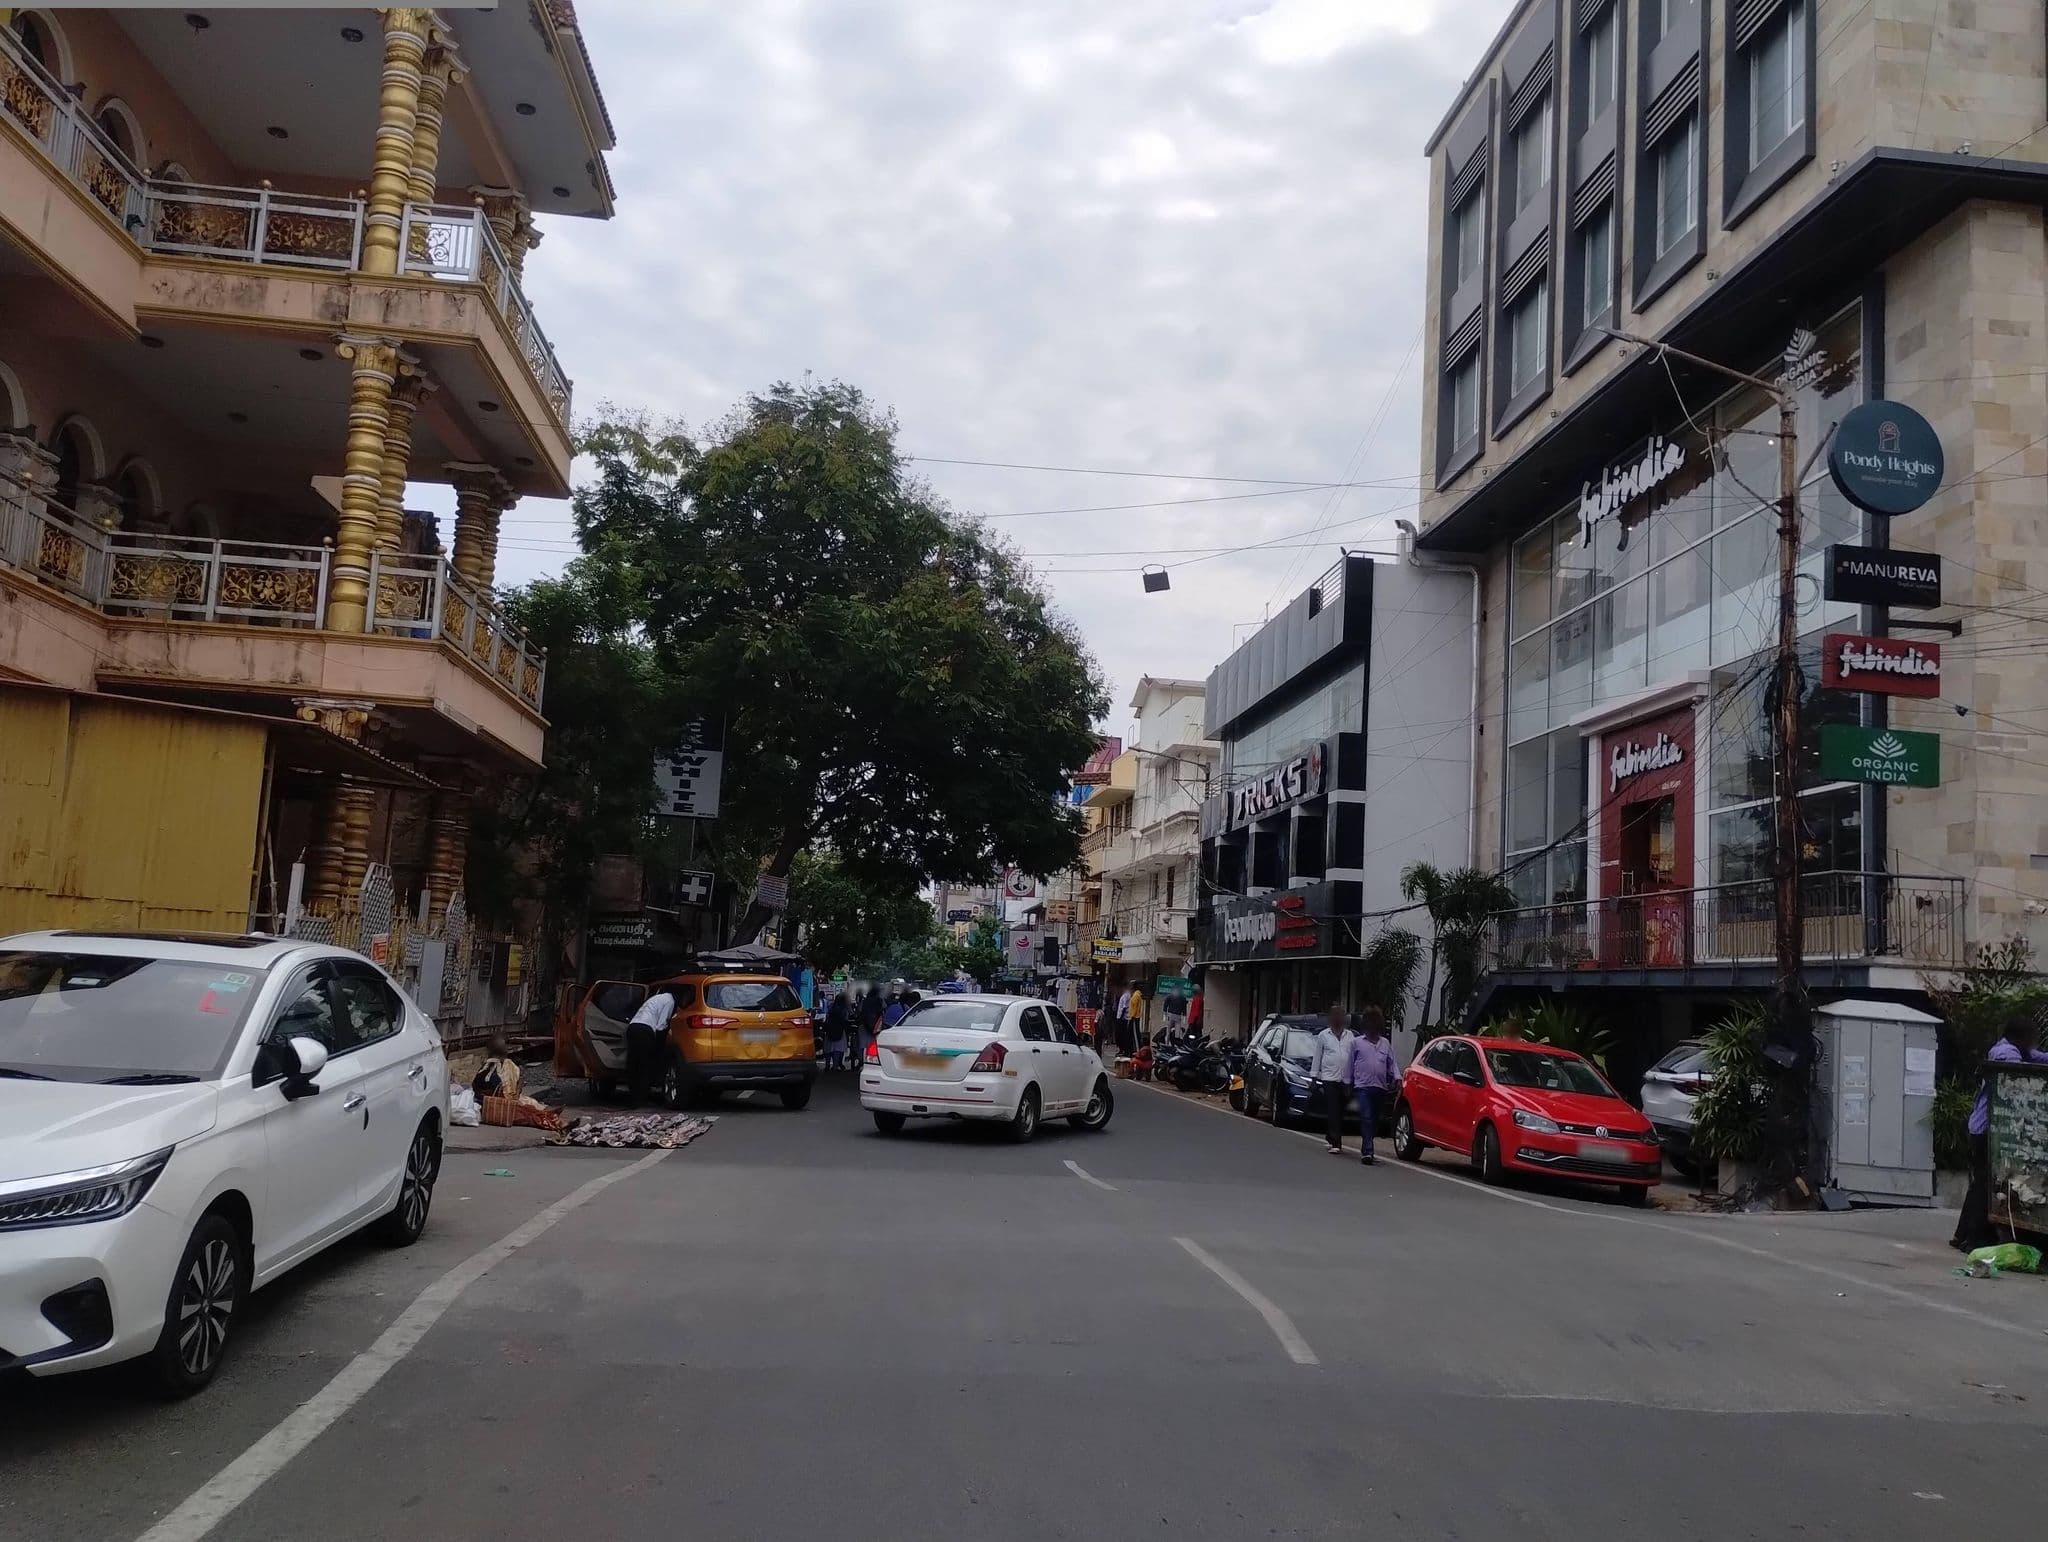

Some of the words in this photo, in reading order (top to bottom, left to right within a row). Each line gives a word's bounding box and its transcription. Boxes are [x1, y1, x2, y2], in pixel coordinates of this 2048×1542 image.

[1844, 451, 1883, 472] Pondy
[1888, 456, 1936, 480] Heights
[1578, 435, 1686, 548] fabindia
[1850, 561, 1938, 583] MANUREVA
[1840, 641, 1940, 678] fabindia
[1610, 732, 1683, 793] fabindia
[1851, 757, 1920, 773] ORGANIC
[1865, 769, 1908, 783] INDIA
